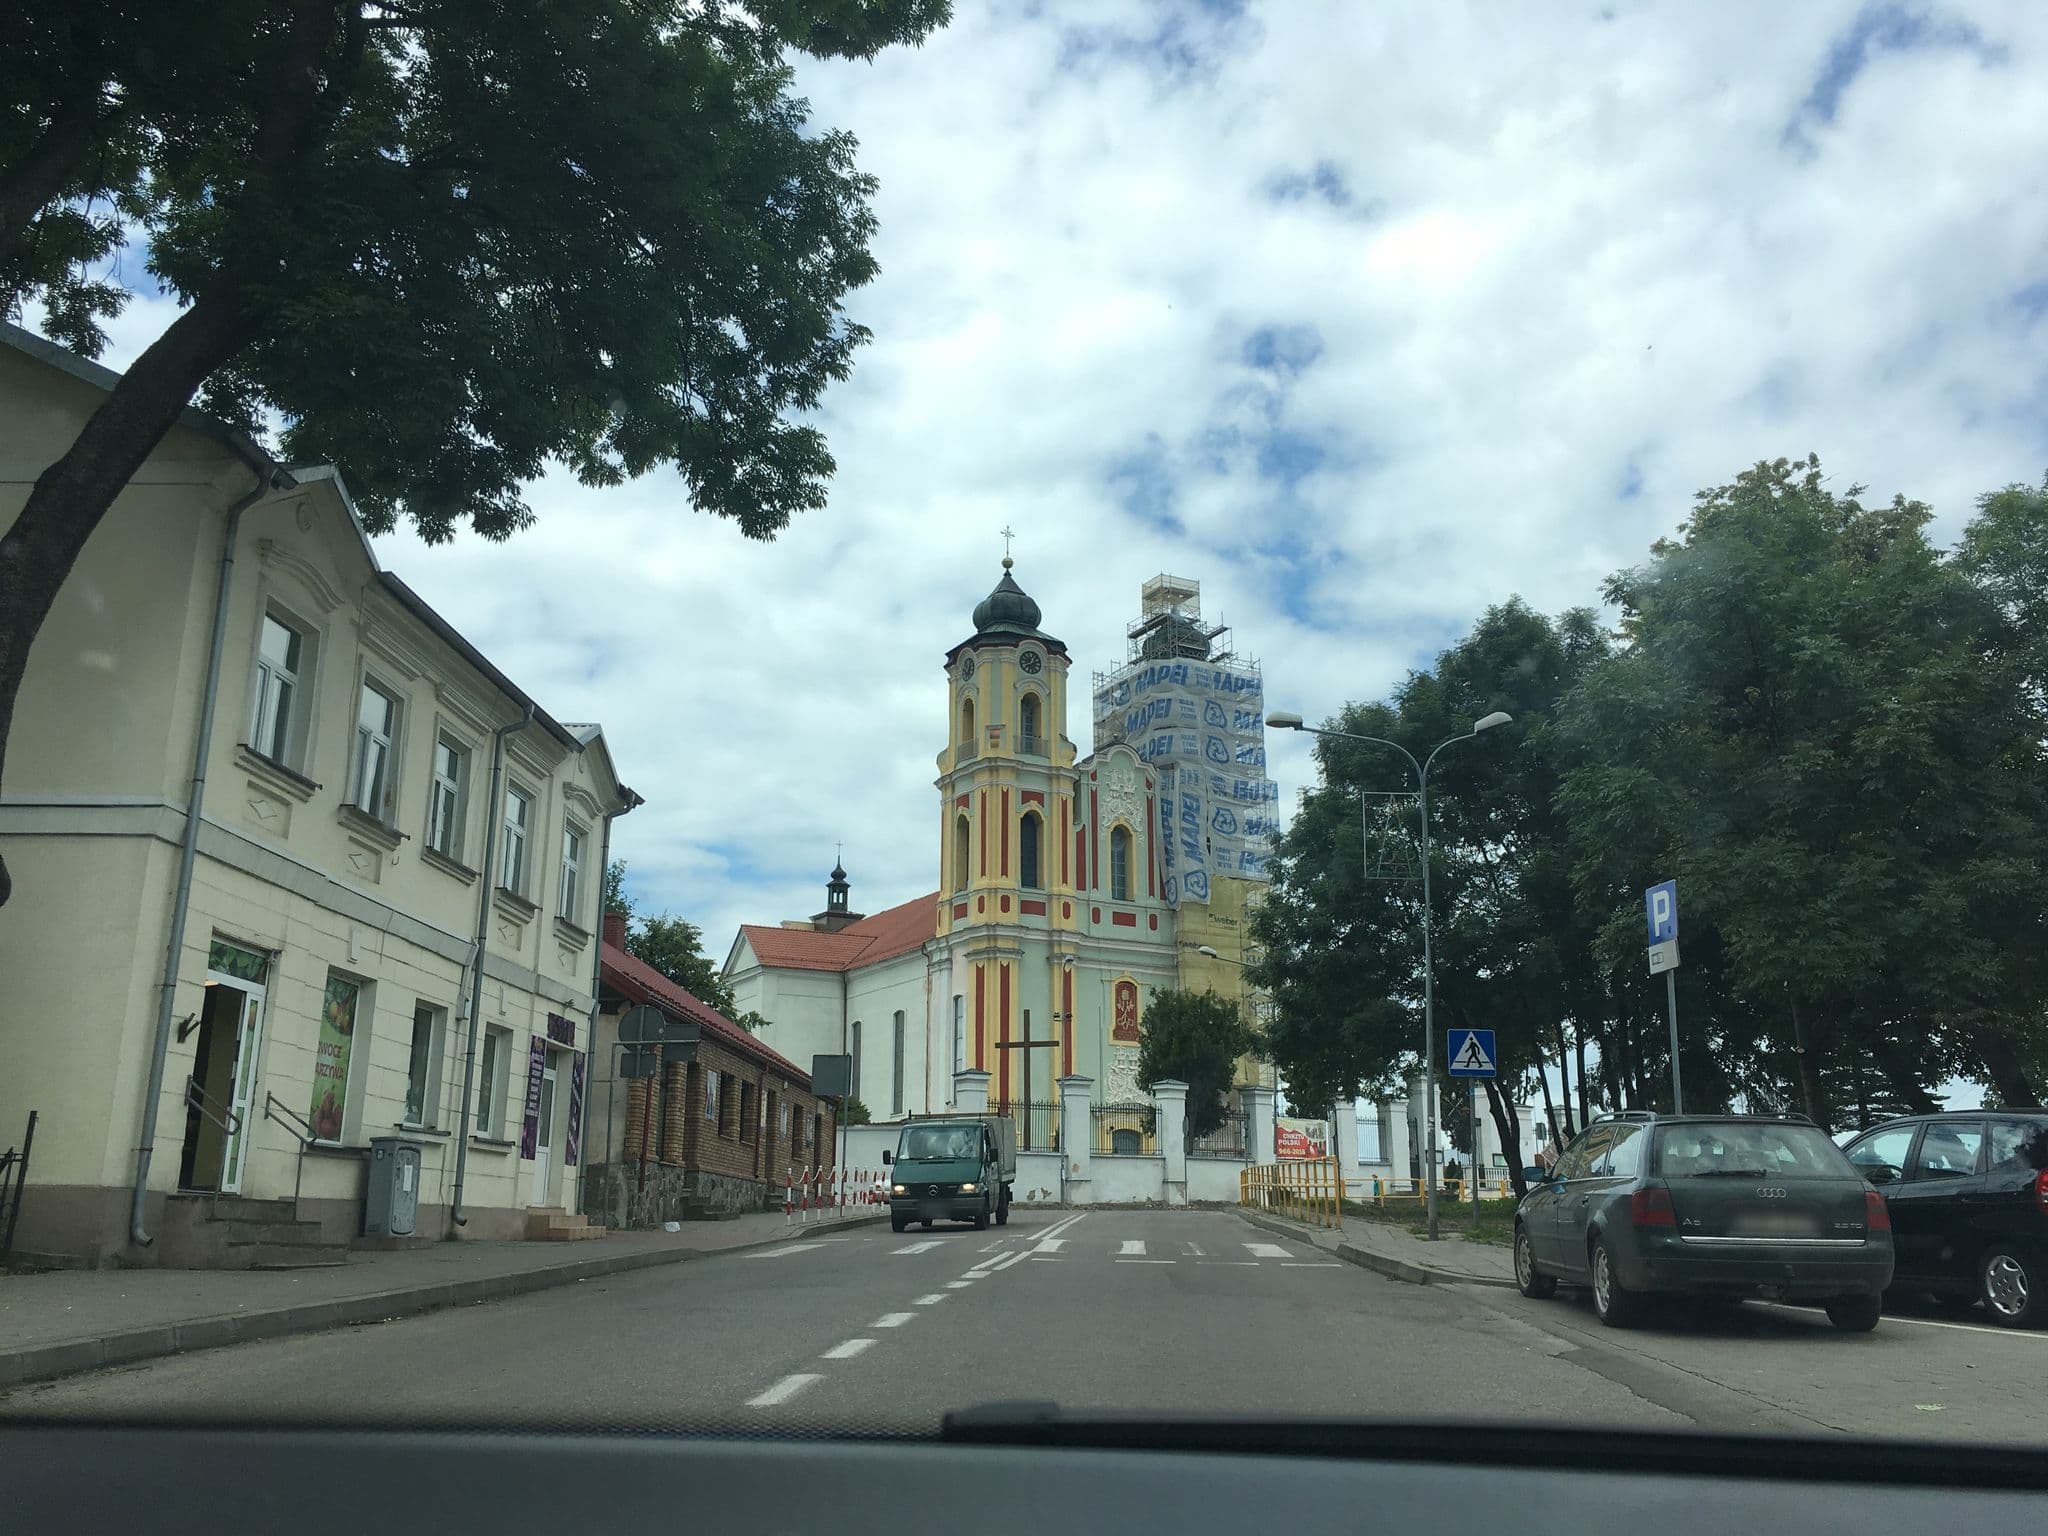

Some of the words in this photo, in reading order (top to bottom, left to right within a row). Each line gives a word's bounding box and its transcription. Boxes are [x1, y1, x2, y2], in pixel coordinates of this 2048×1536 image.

[1135, 664, 1188, 696] MAPEI
[1126, 698, 1172, 735] MAPEI
[1160, 797, 1175, 869] MAPEI
[1180, 791, 1204, 865] MAPEI
[1214, 915, 1238, 926] weber
[1653, 890, 1669, 937] P
